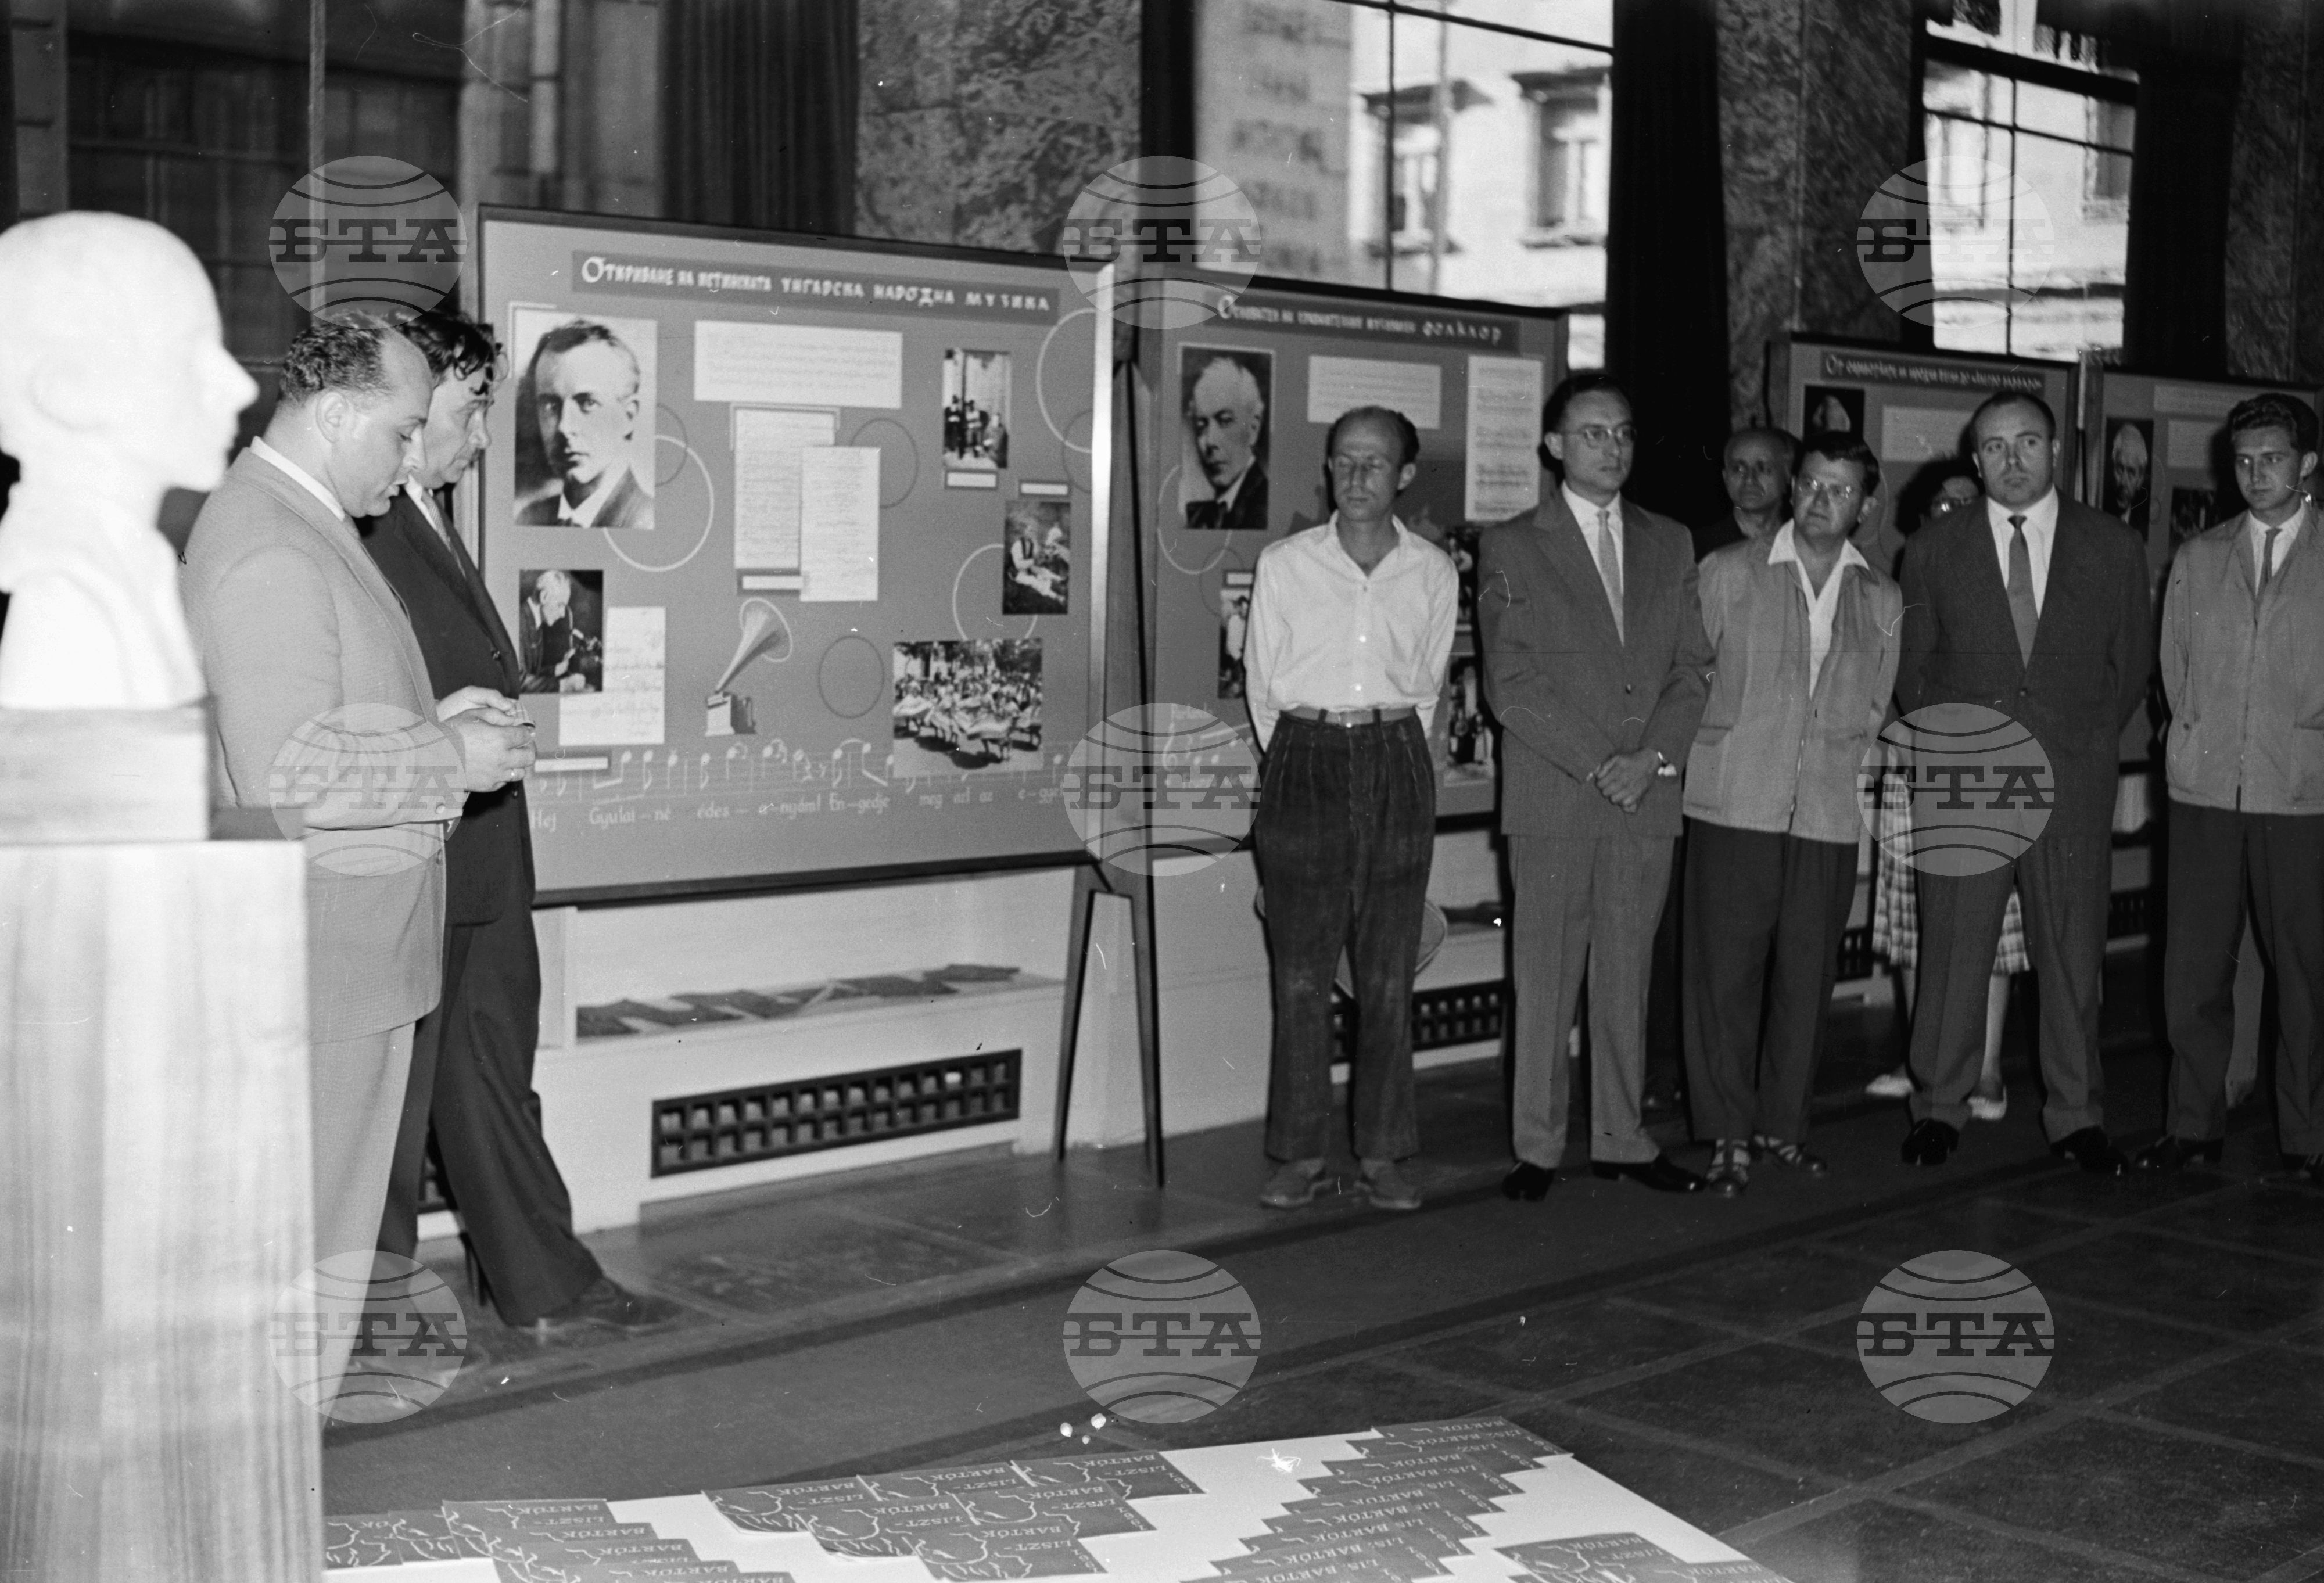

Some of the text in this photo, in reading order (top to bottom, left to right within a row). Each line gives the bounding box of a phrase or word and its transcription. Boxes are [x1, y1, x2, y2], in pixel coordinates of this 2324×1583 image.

[781, 277, 864, 298] УНГАРСКА
[873, 284, 955, 307] НАРОДНА
[964, 292, 1050, 311] МУЗИКА
